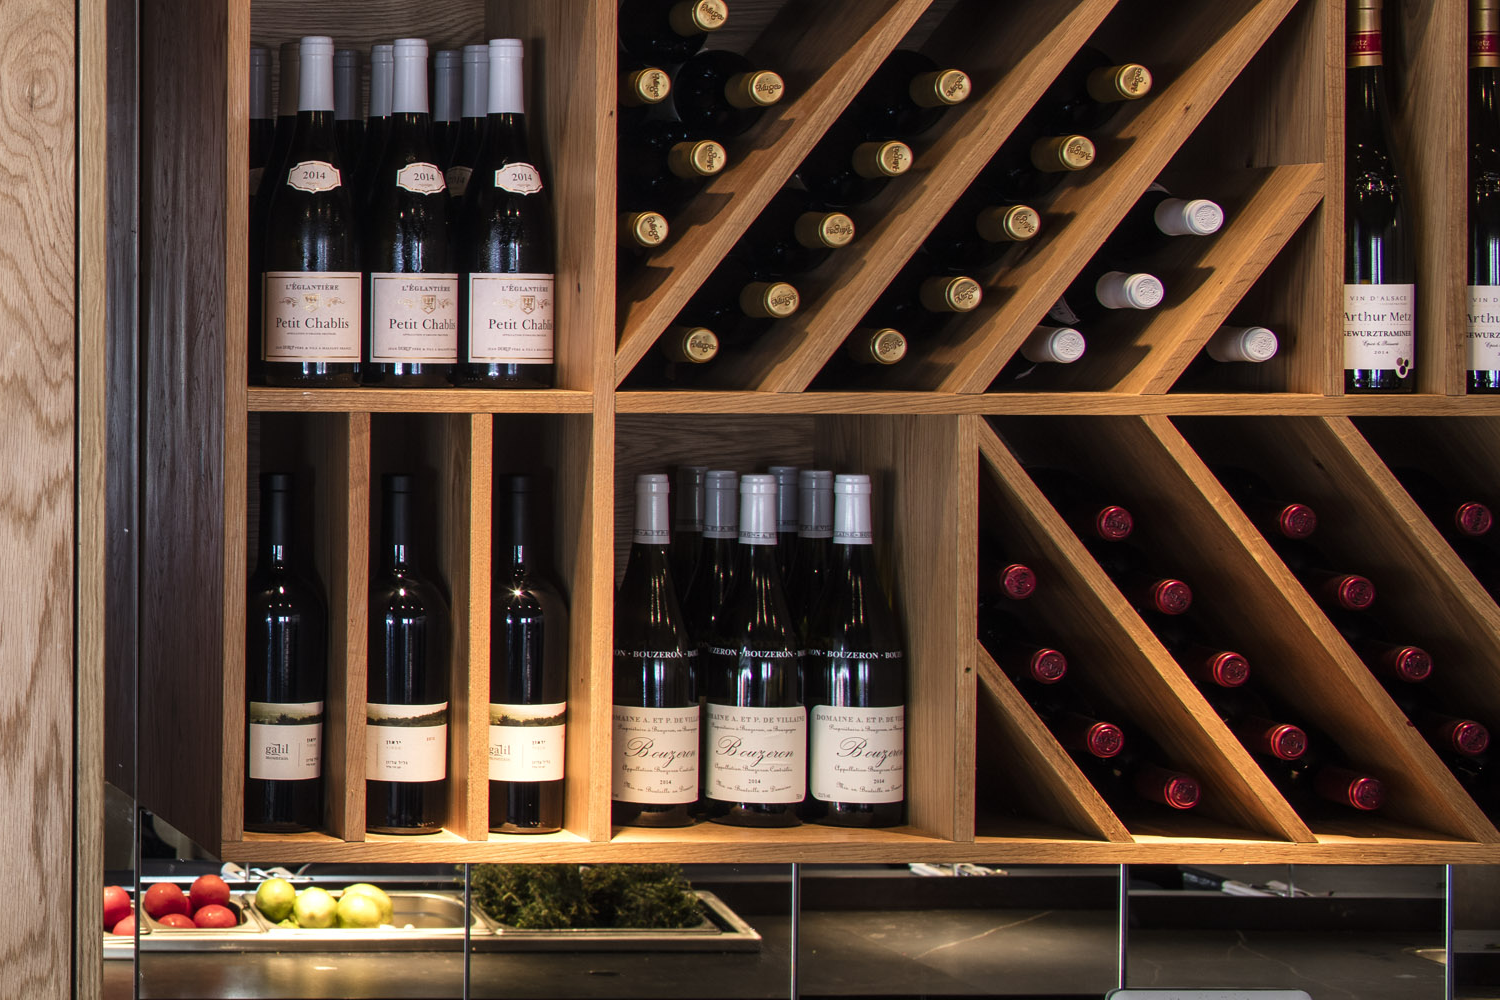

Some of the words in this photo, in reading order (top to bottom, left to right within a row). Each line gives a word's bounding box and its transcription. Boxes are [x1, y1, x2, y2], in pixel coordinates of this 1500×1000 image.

[303, 171, 325, 179] 2014
[414, 172, 436, 181] 2014
[512, 173, 533, 181] 2014
[285, 282, 339, 290] L'ÉGLANTIÈRE
[1344, 312, 1387, 322] Arthur
[1390, 312, 1412, 322] Metz
[276, 317, 300, 328] Petit
[305, 317, 349, 329] Chablis
[389, 318, 418, 330] Petit
[488, 318, 517, 330] Petit
[633, 649, 682, 658] BOUZERON
[744, 650, 794, 658] BOUZERON
[827, 650, 879, 659] BOUZERON
[816, 714, 853, 722] DOMAINE
[266, 743, 288, 756] galil
[489, 744, 510, 757] galil
[624, 736, 696, 769] Bouzeron
[715, 735, 794, 767] Bouzeron
